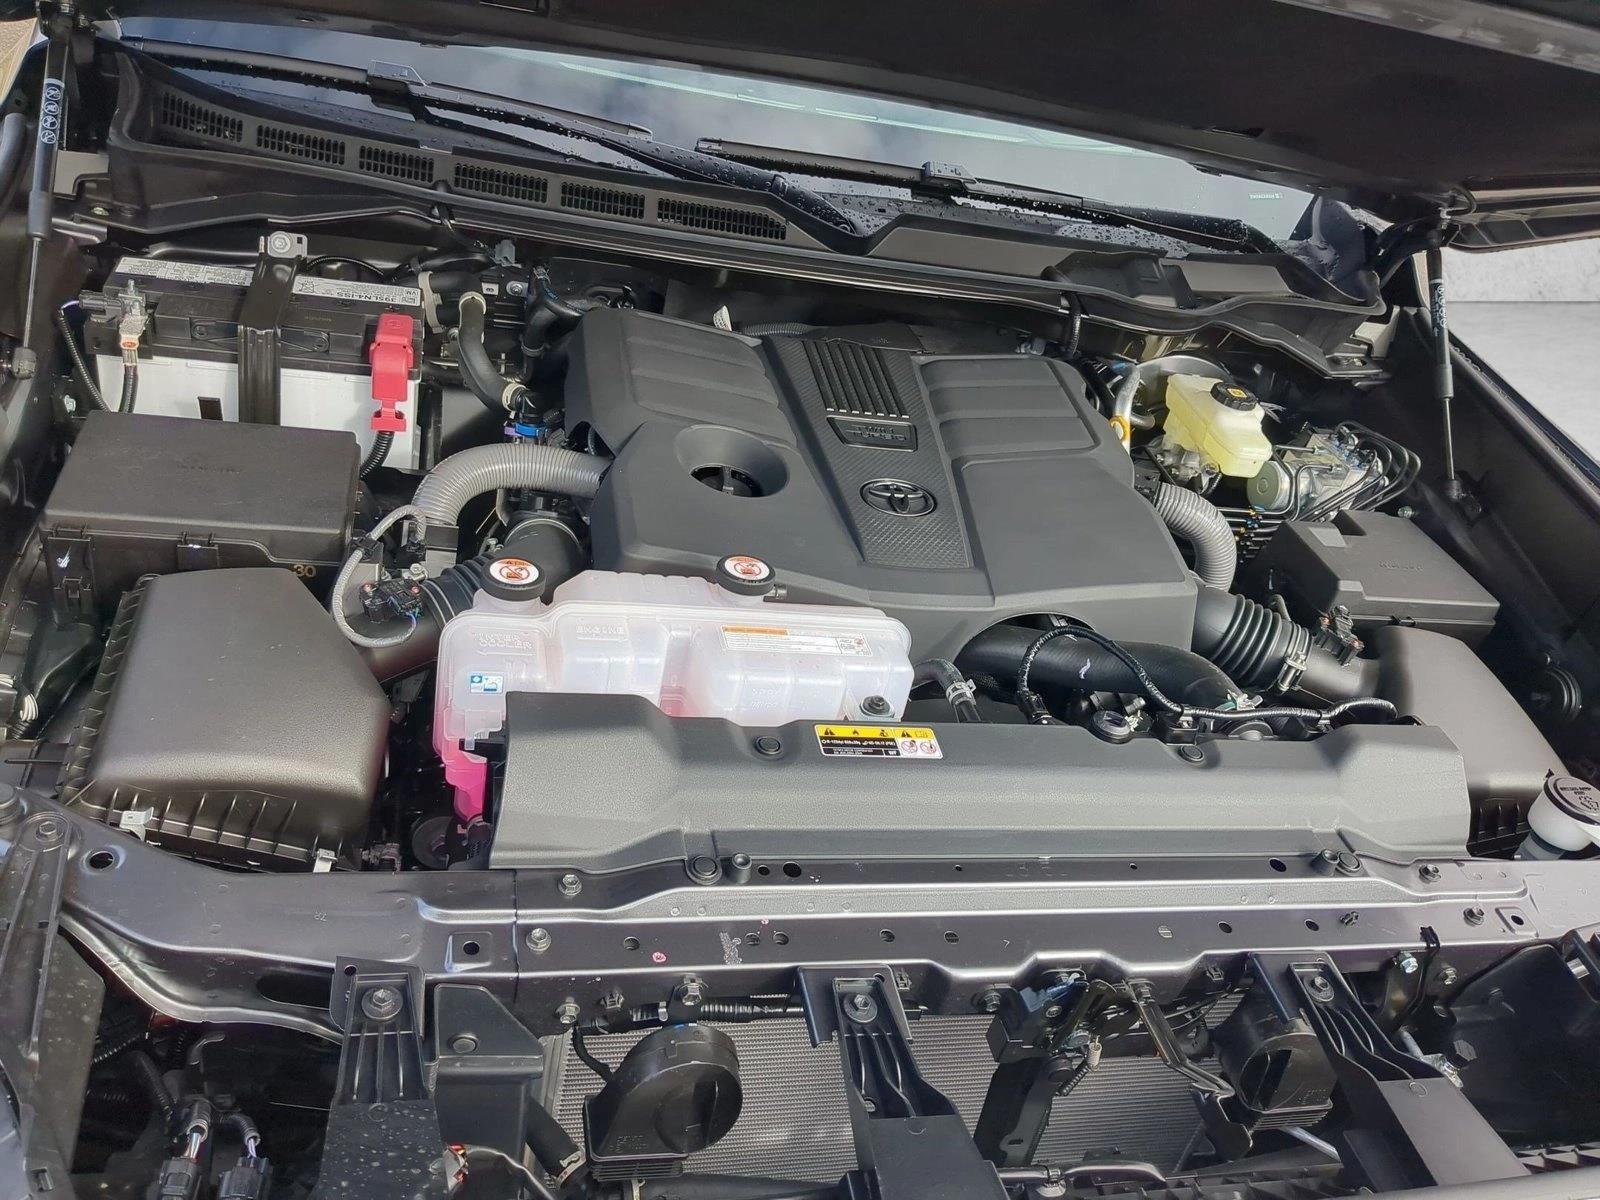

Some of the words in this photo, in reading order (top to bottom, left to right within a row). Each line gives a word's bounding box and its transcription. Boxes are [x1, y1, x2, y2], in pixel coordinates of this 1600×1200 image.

[293, 564, 316, 578] 30
[575, 625, 625, 635] ENGINE
[479, 640, 533, 650] COOLER
